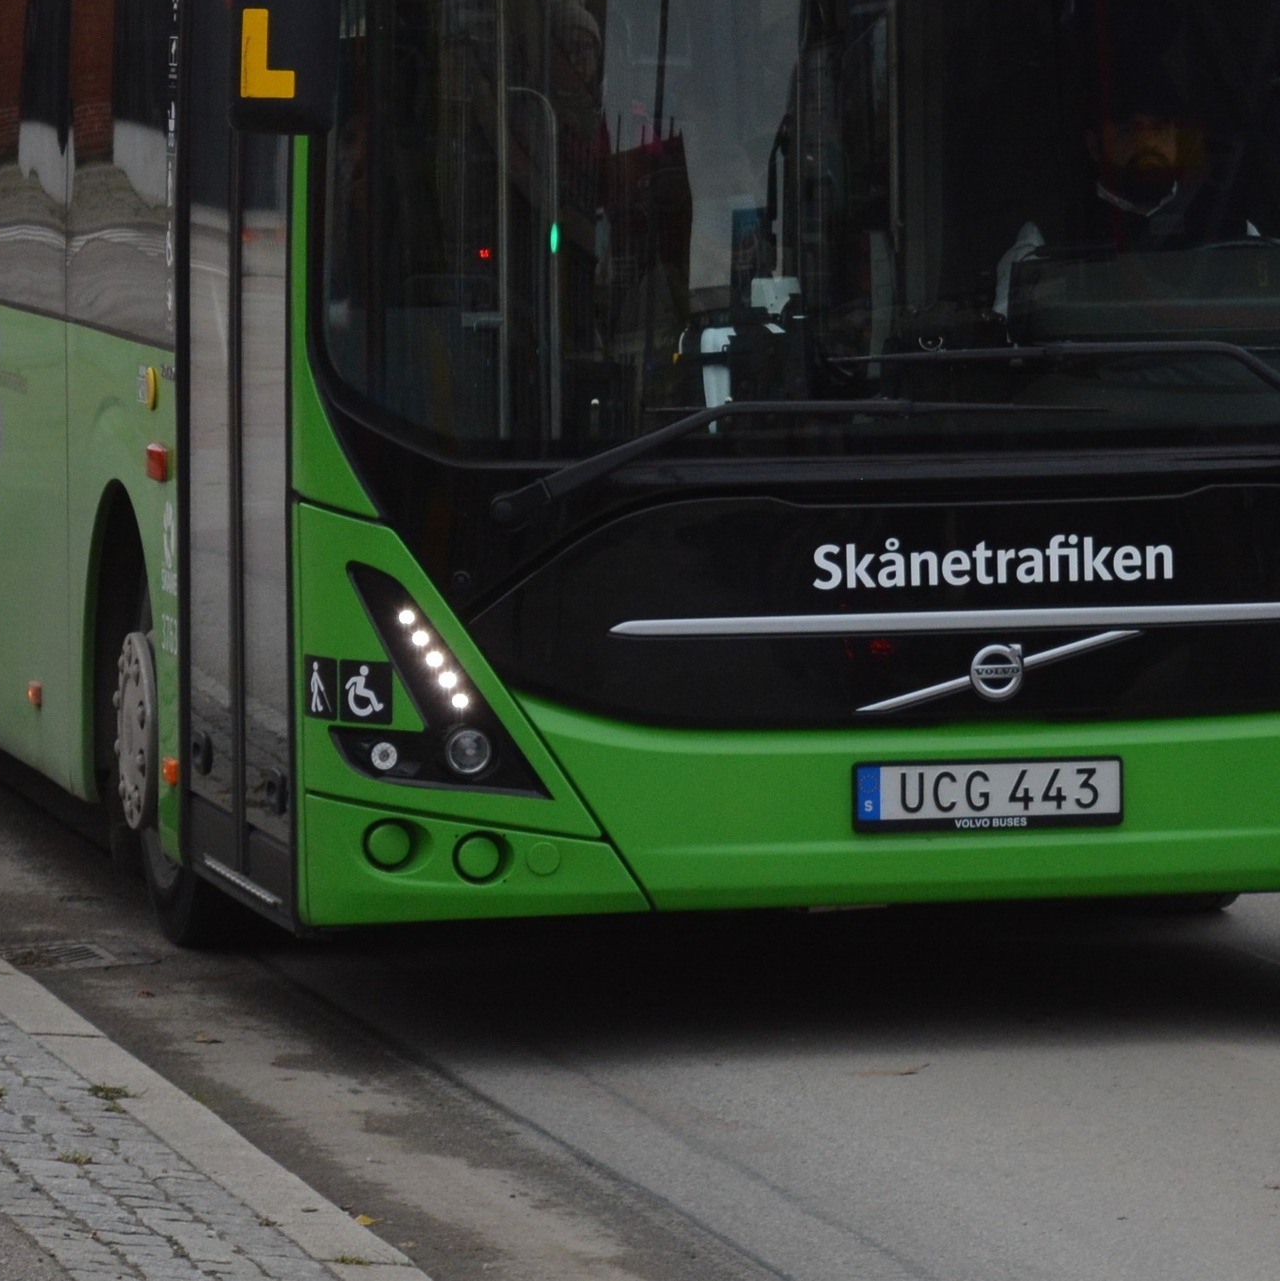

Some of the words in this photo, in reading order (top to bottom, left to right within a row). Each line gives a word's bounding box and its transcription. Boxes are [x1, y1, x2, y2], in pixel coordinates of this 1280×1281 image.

[813, 534, 1173, 590] Skånetrafiken
[974, 666, 1020, 676] VOLVO
[899, 770, 990, 814] UCG
[1007, 767, 1100, 812] 443
[864, 799, 873, 813] S
[955, 818, 990, 829] VOLVO
[992, 816, 1028, 827] BUSES
